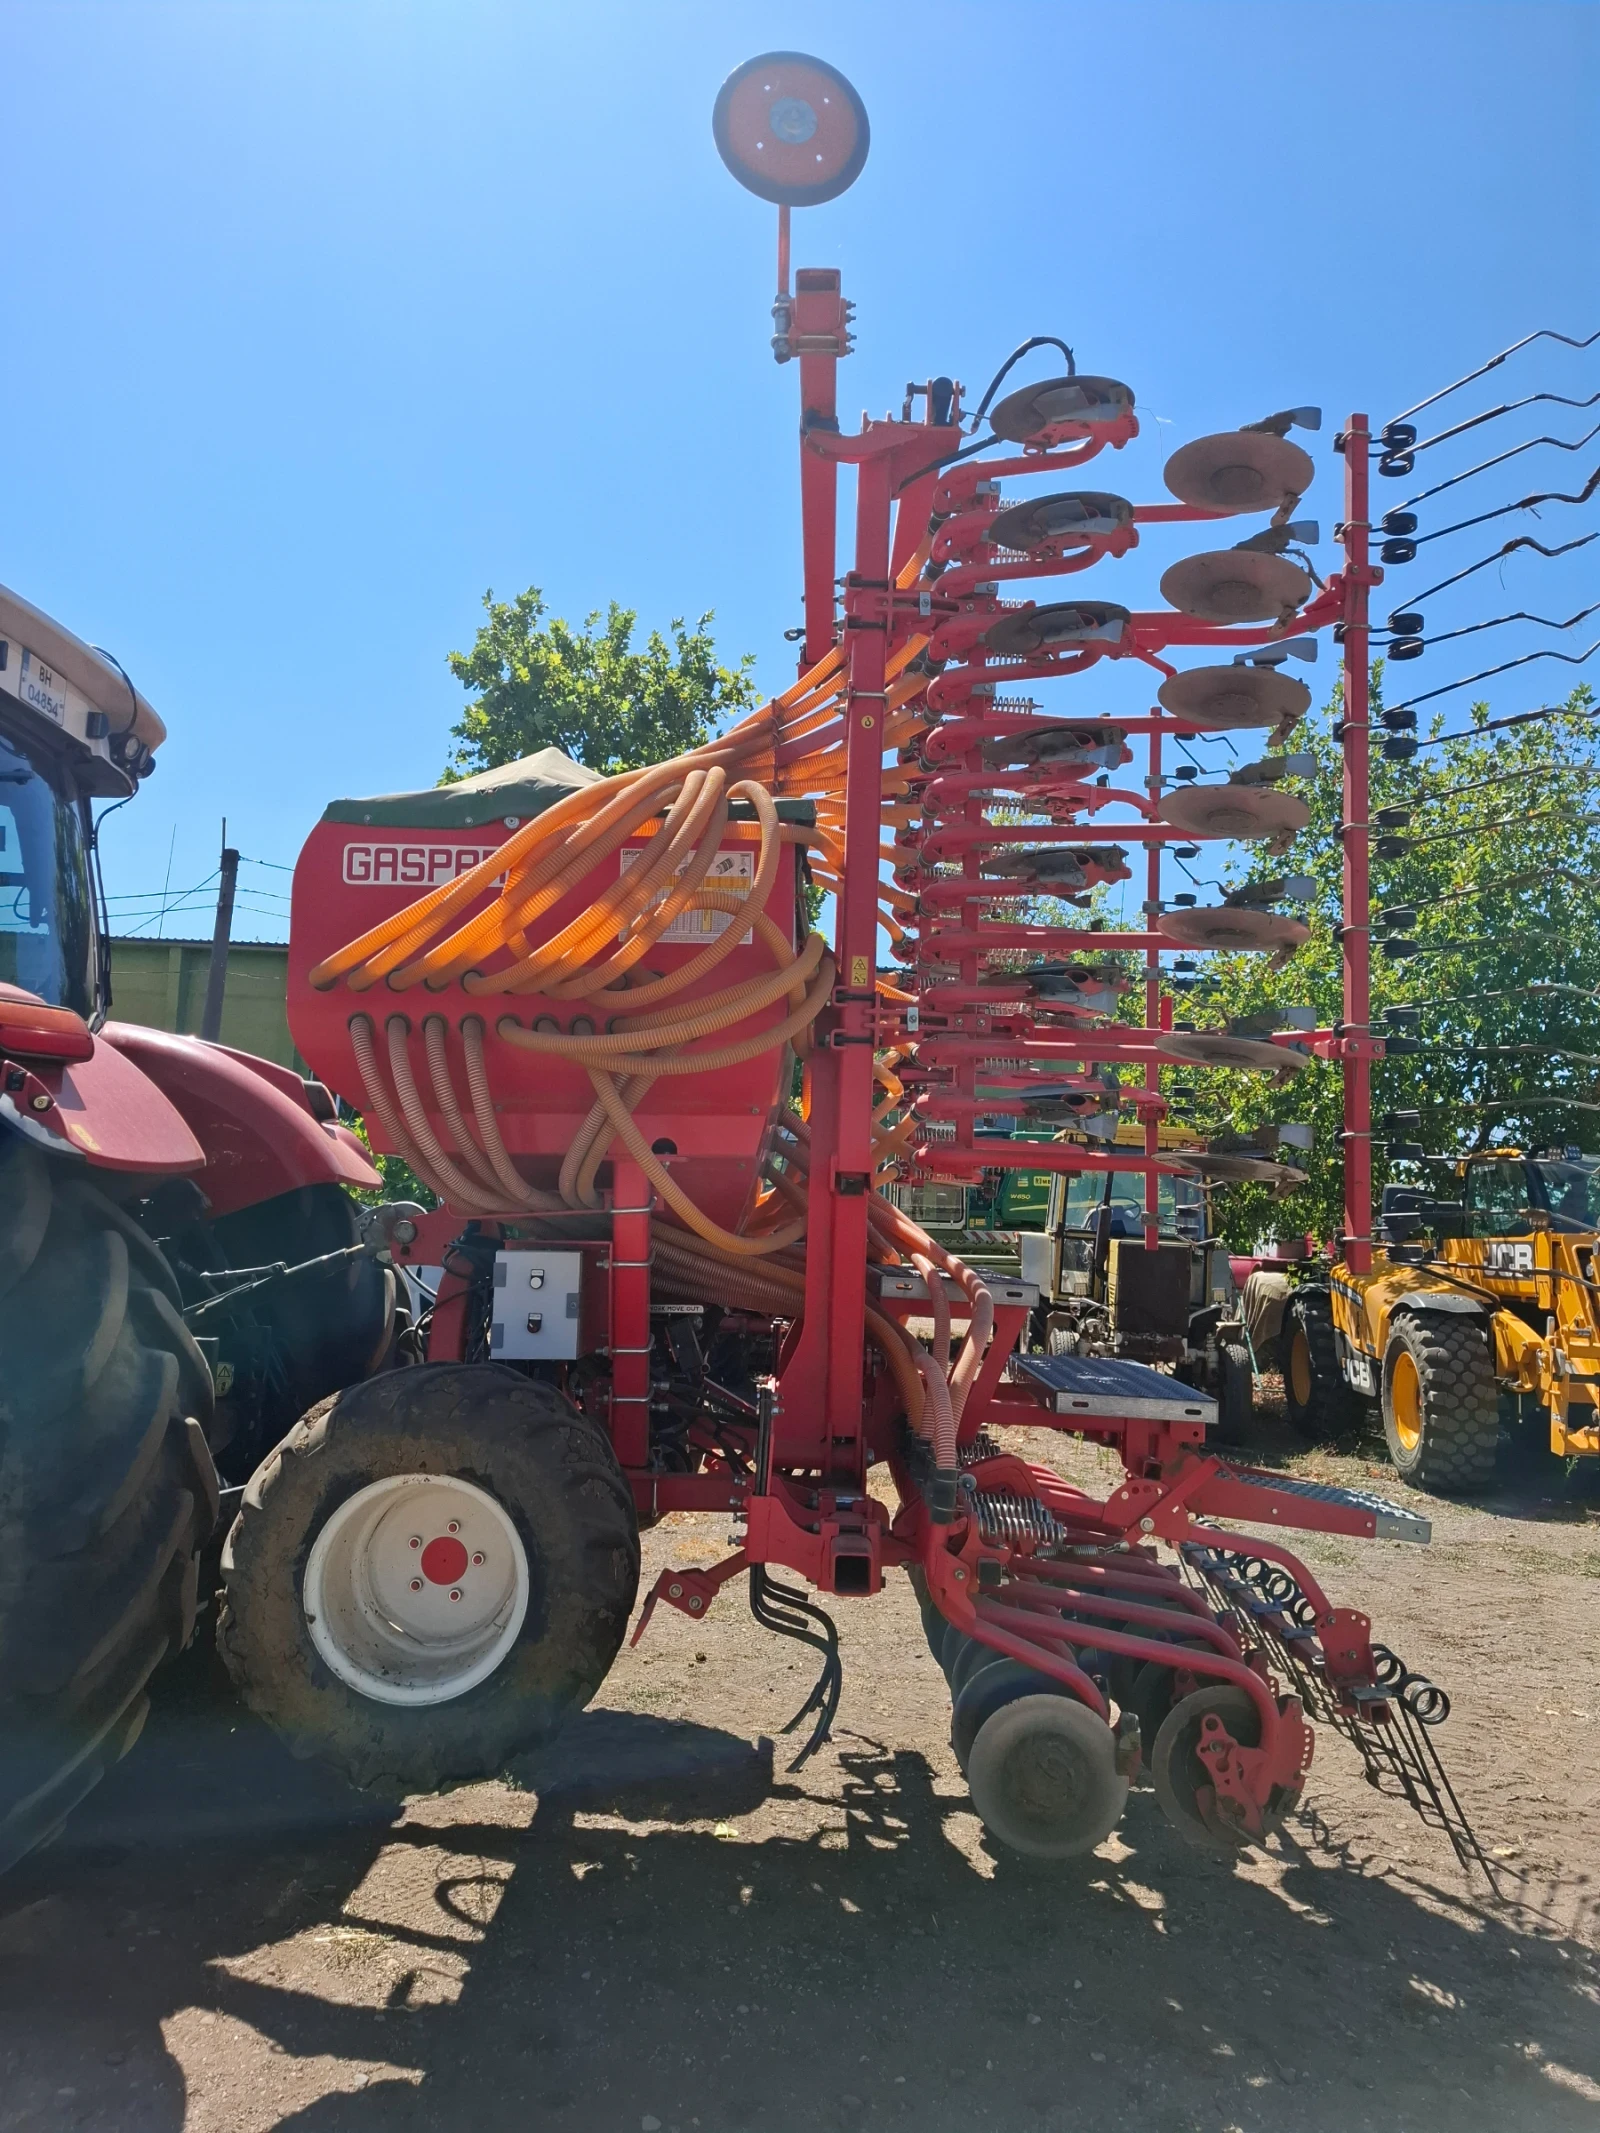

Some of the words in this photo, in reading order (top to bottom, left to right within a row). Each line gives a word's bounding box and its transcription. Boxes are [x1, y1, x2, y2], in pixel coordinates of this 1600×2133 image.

[28, 684, 58, 717] 04854
[346, 847, 507, 884] GASPA
[1483, 1244, 1532, 1277] JCB
[1342, 1357, 1370, 1388] JCB
